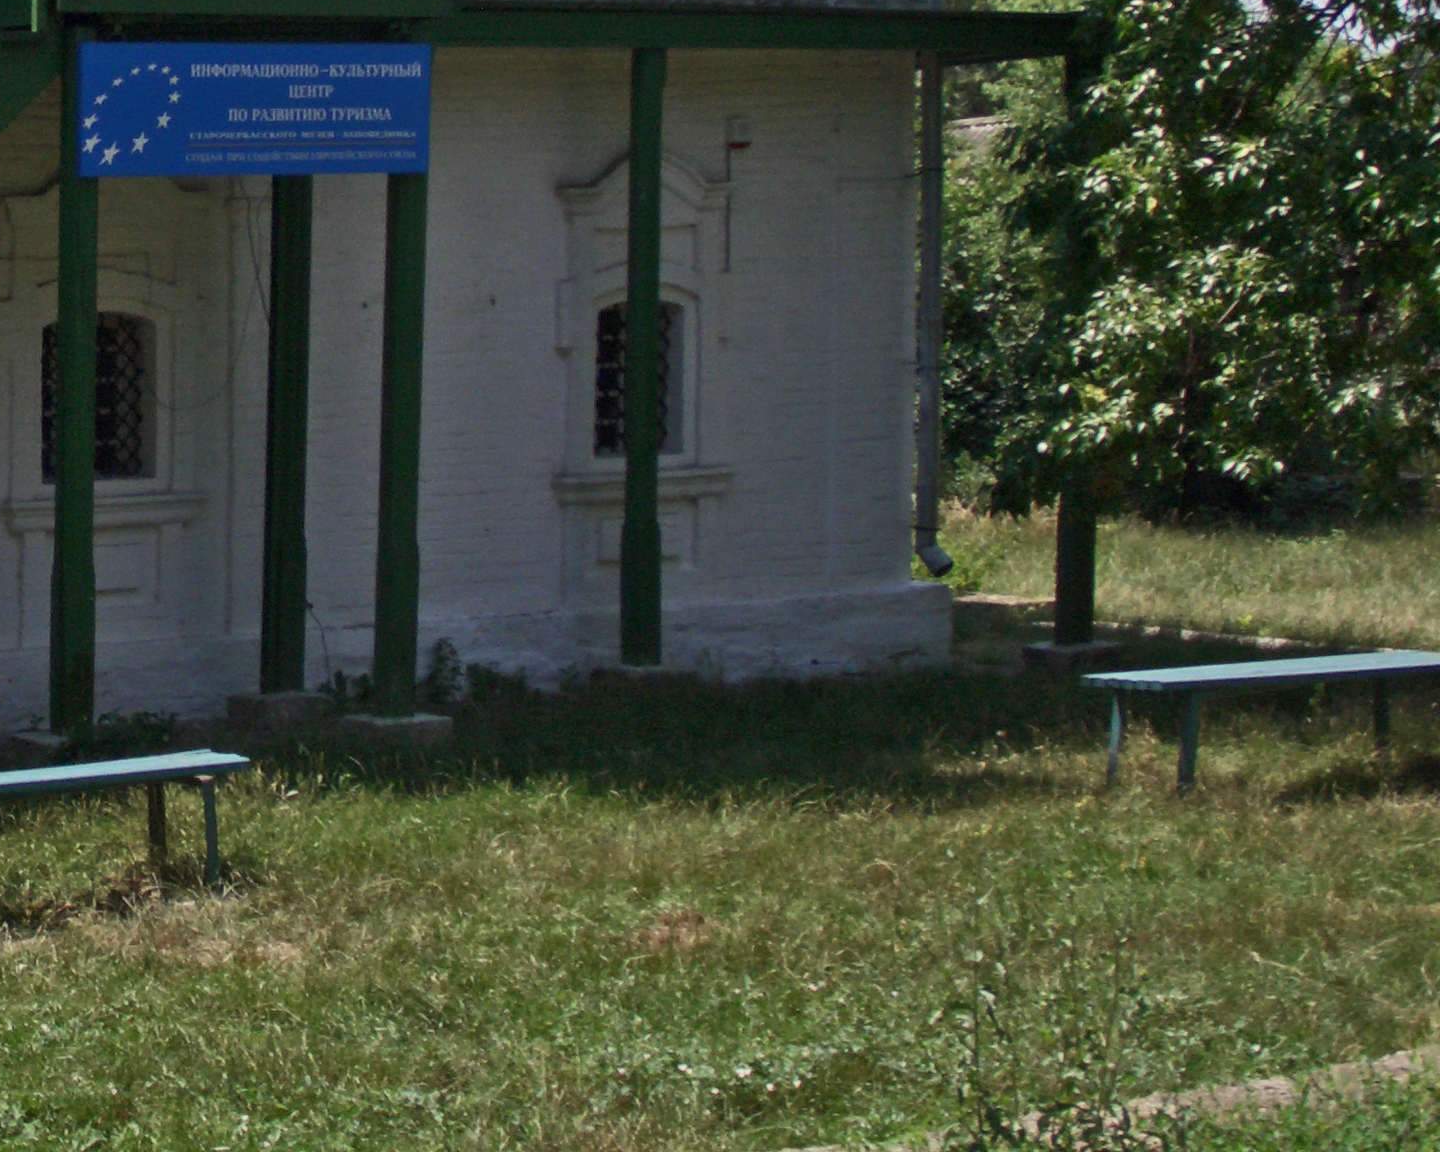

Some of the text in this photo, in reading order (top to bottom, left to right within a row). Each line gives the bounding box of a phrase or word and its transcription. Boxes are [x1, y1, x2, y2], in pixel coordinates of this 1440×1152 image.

[289, 84, 335, 99] ЦЕНТР
[228, 107, 392, 122] ПО РАЗВИТИЮ ТУРИЗМА
